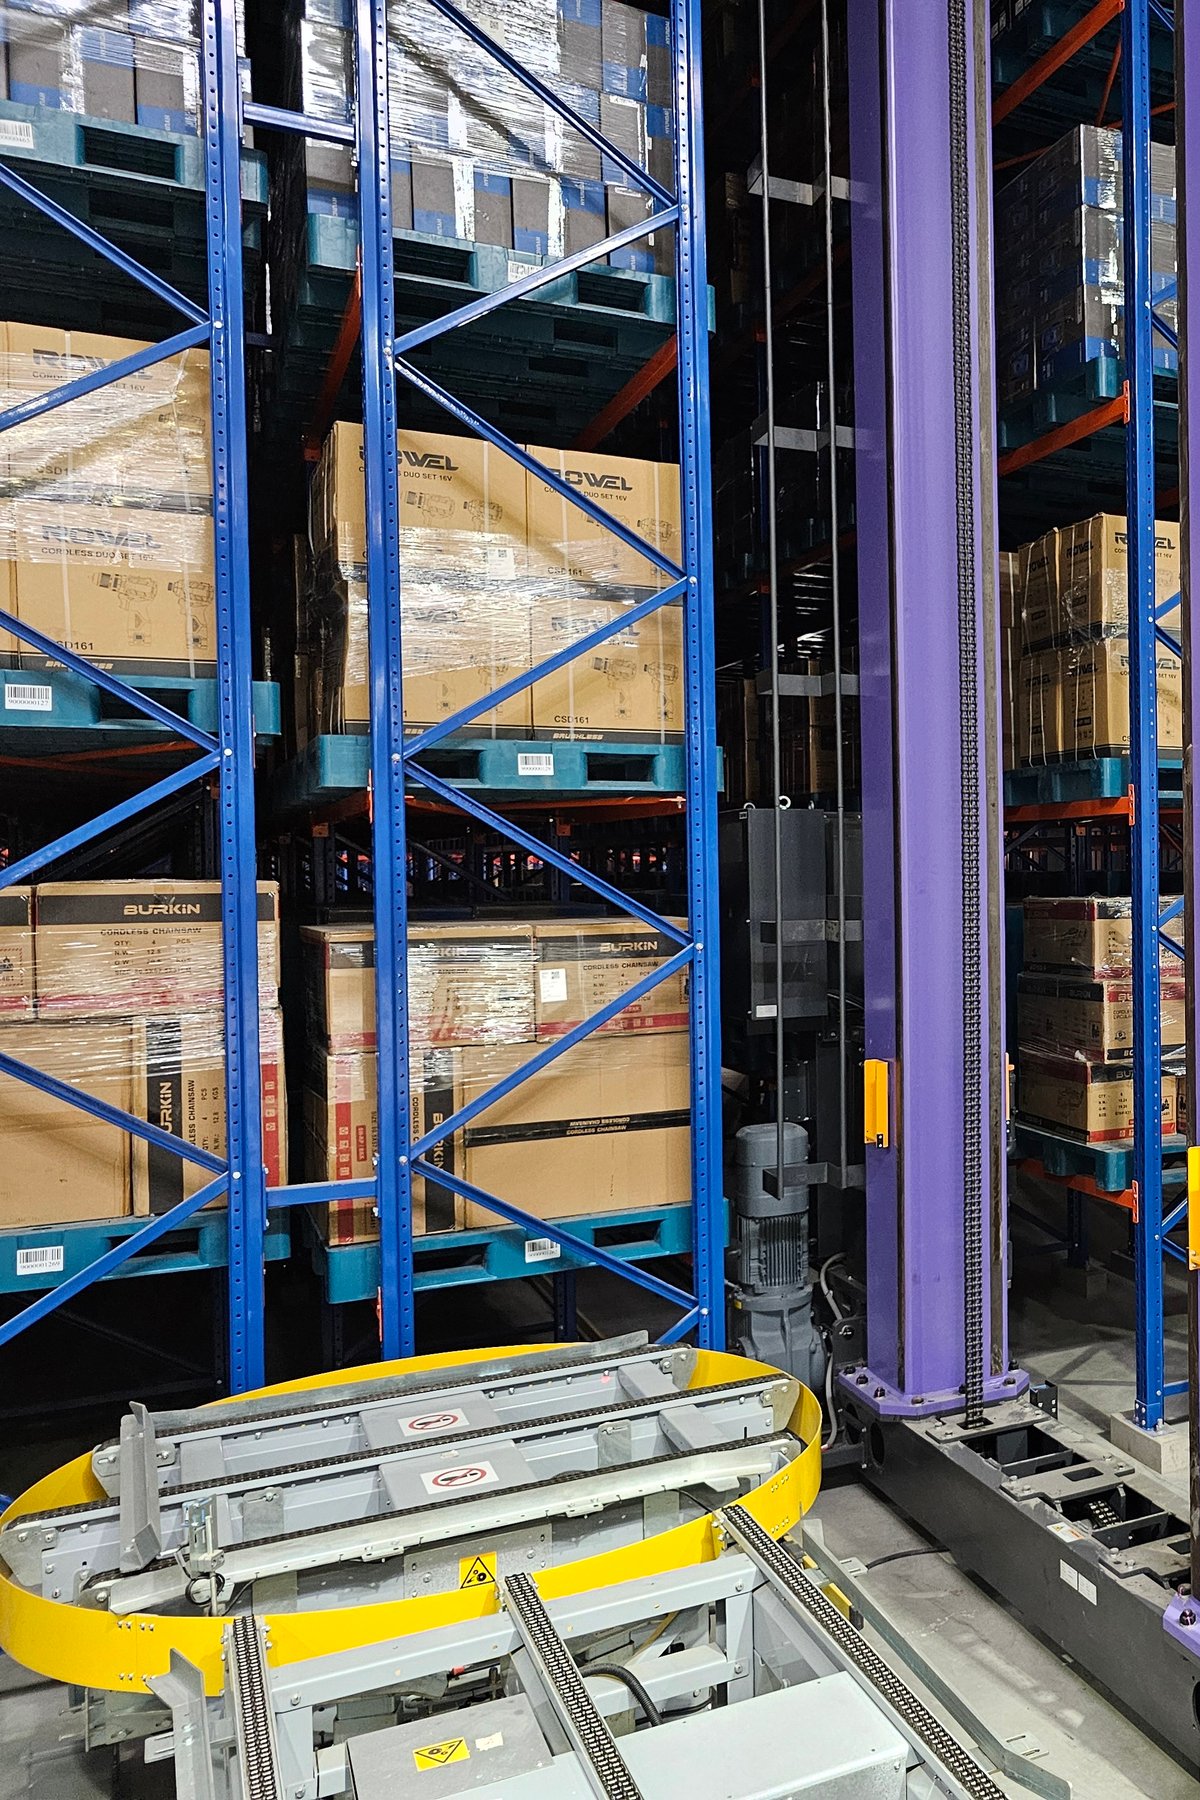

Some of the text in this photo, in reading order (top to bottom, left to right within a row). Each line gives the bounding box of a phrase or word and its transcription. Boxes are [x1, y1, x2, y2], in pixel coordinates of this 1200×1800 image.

[403, 472, 453, 482] DUO SET 16V
[600, 492, 614, 500] SET
[621, 961, 659, 969] CHAINSAW
[188, 1079, 196, 1121] CHAINSAW
[412, 1096, 420, 1134] CORDLESS
